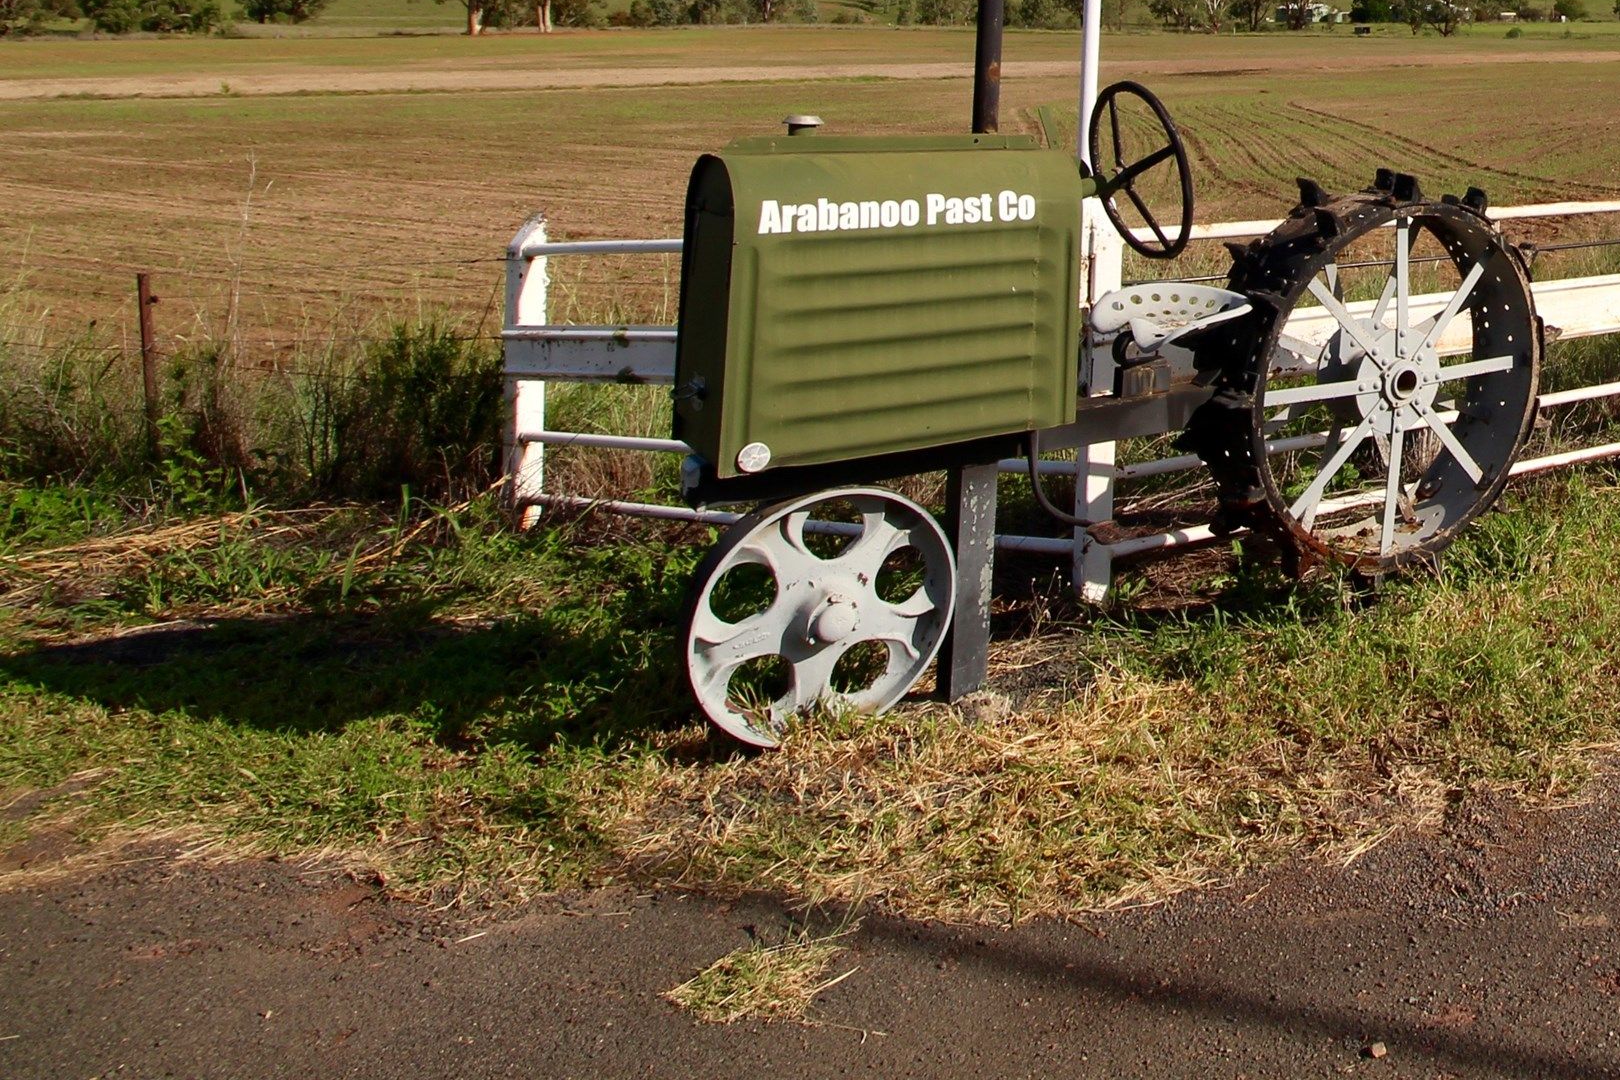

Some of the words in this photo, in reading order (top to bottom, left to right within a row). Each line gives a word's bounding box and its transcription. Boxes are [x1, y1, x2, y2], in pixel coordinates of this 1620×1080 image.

[758, 197, 920, 234] Arabanoo
[926, 193, 993, 225] Past
[998, 190, 1036, 222] Co
